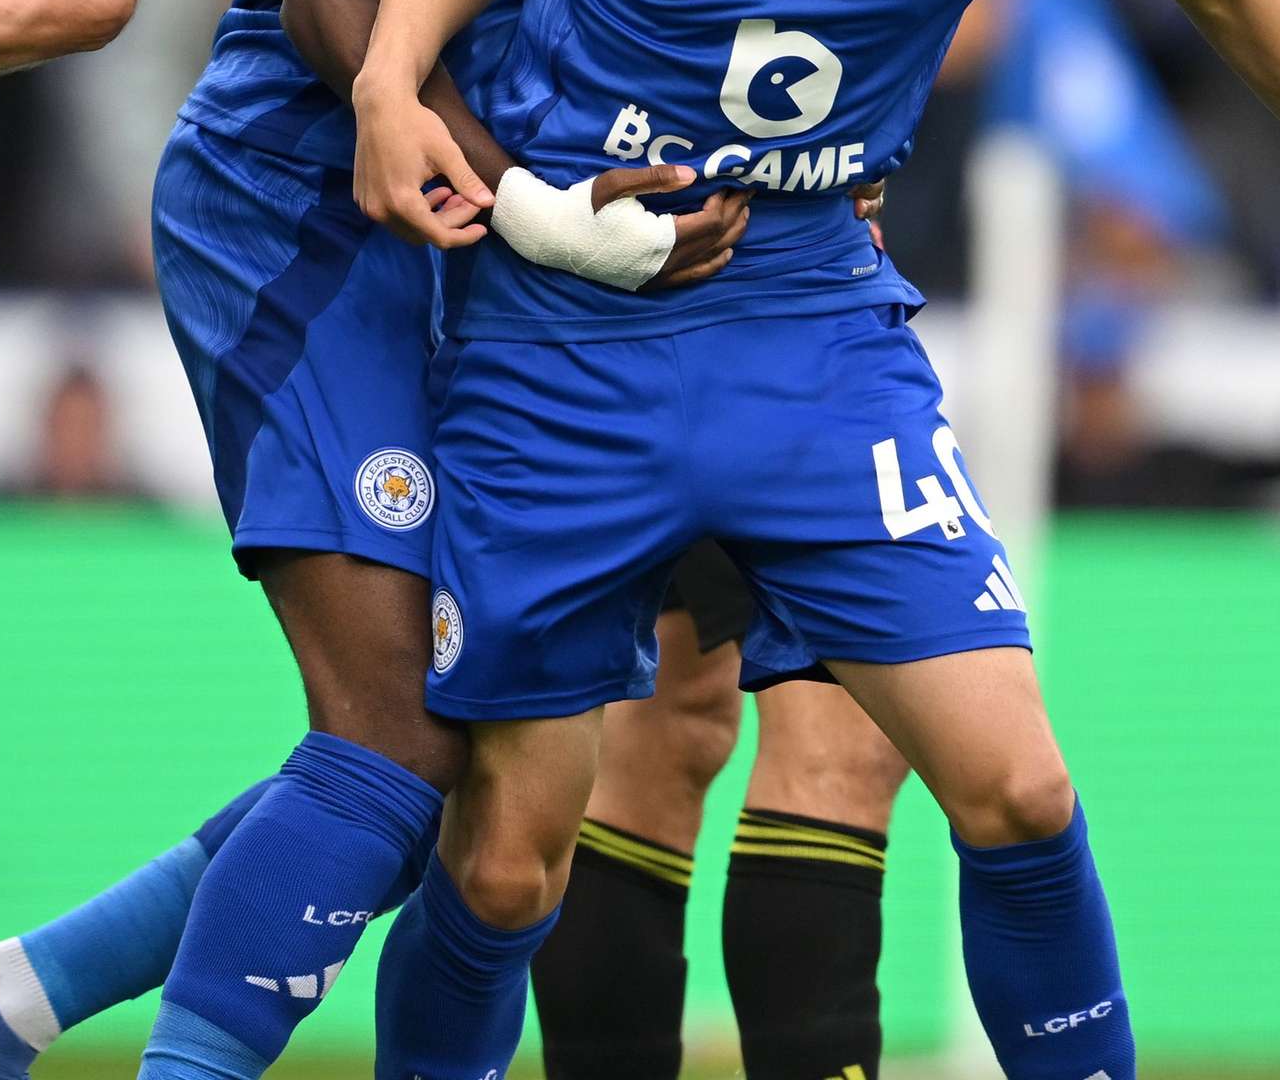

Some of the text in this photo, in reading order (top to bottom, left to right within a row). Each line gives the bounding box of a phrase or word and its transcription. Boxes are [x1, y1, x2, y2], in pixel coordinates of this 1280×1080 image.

[366, 456, 427, 495] LEICESTER CITY
[363, 486, 425, 521] FOOTBALL CLUB
[1023, 1001, 1113, 1037] LCFC
